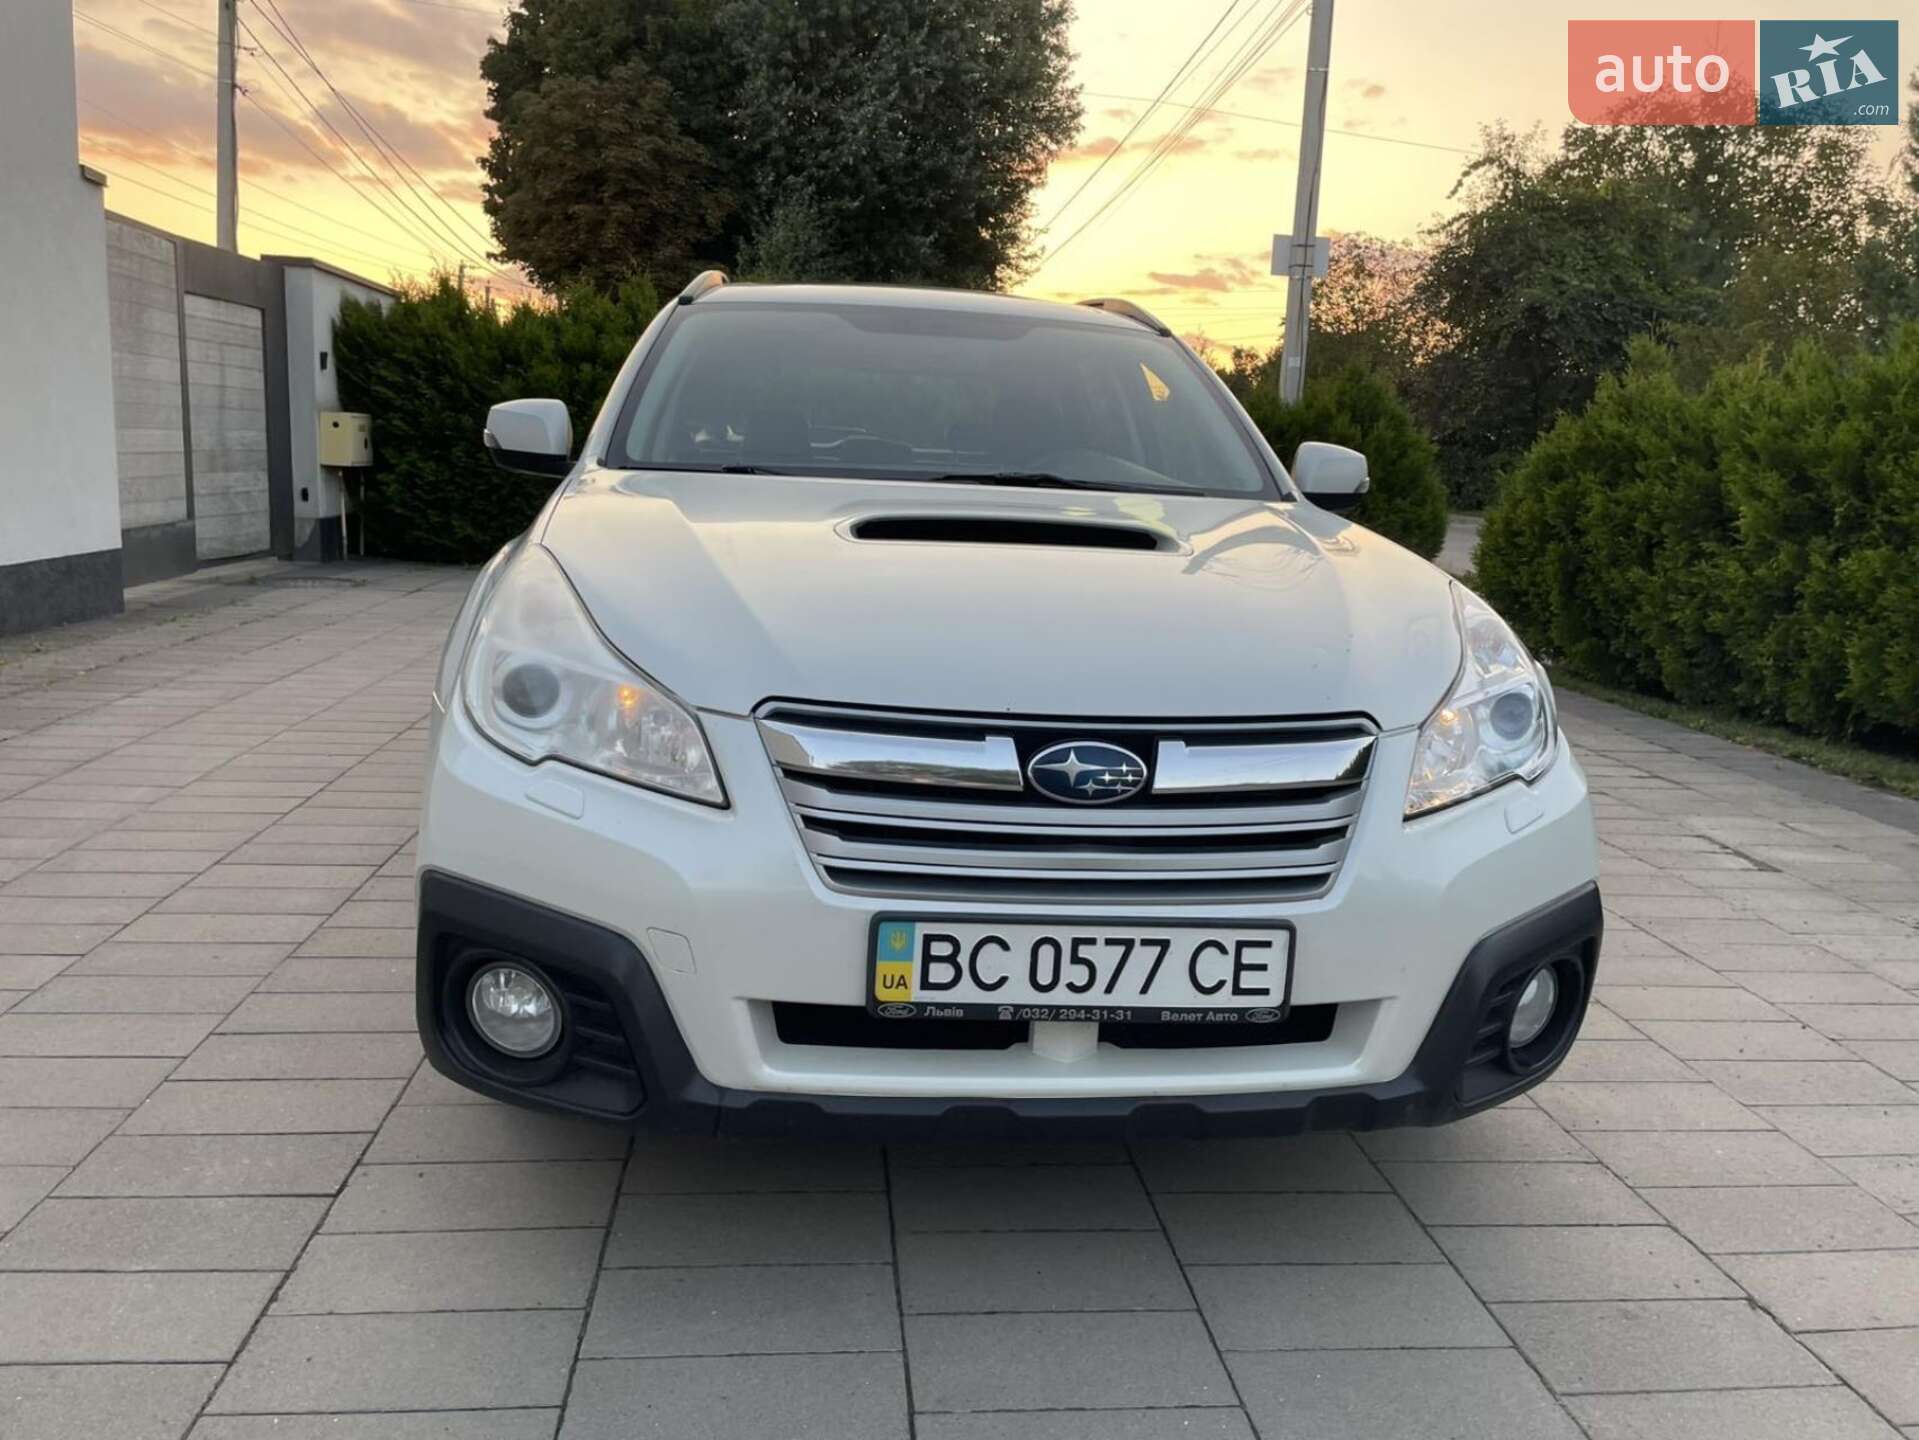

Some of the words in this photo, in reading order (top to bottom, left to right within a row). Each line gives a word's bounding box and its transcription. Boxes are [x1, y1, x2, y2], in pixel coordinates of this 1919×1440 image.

[919, 933, 1010, 992] BC
[1028, 936, 1172, 995] 0577
[1188, 939, 1273, 996] CE
[882, 974, 908, 990] UA
[924, 1006, 964, 1017] Львів
[1015, 1008, 1056, 1020] /032/
[1059, 1009, 1132, 1021] 294-31-31
[1161, 1010, 1203, 1021] Велет
[1206, 1010, 1239, 1022] Авто
